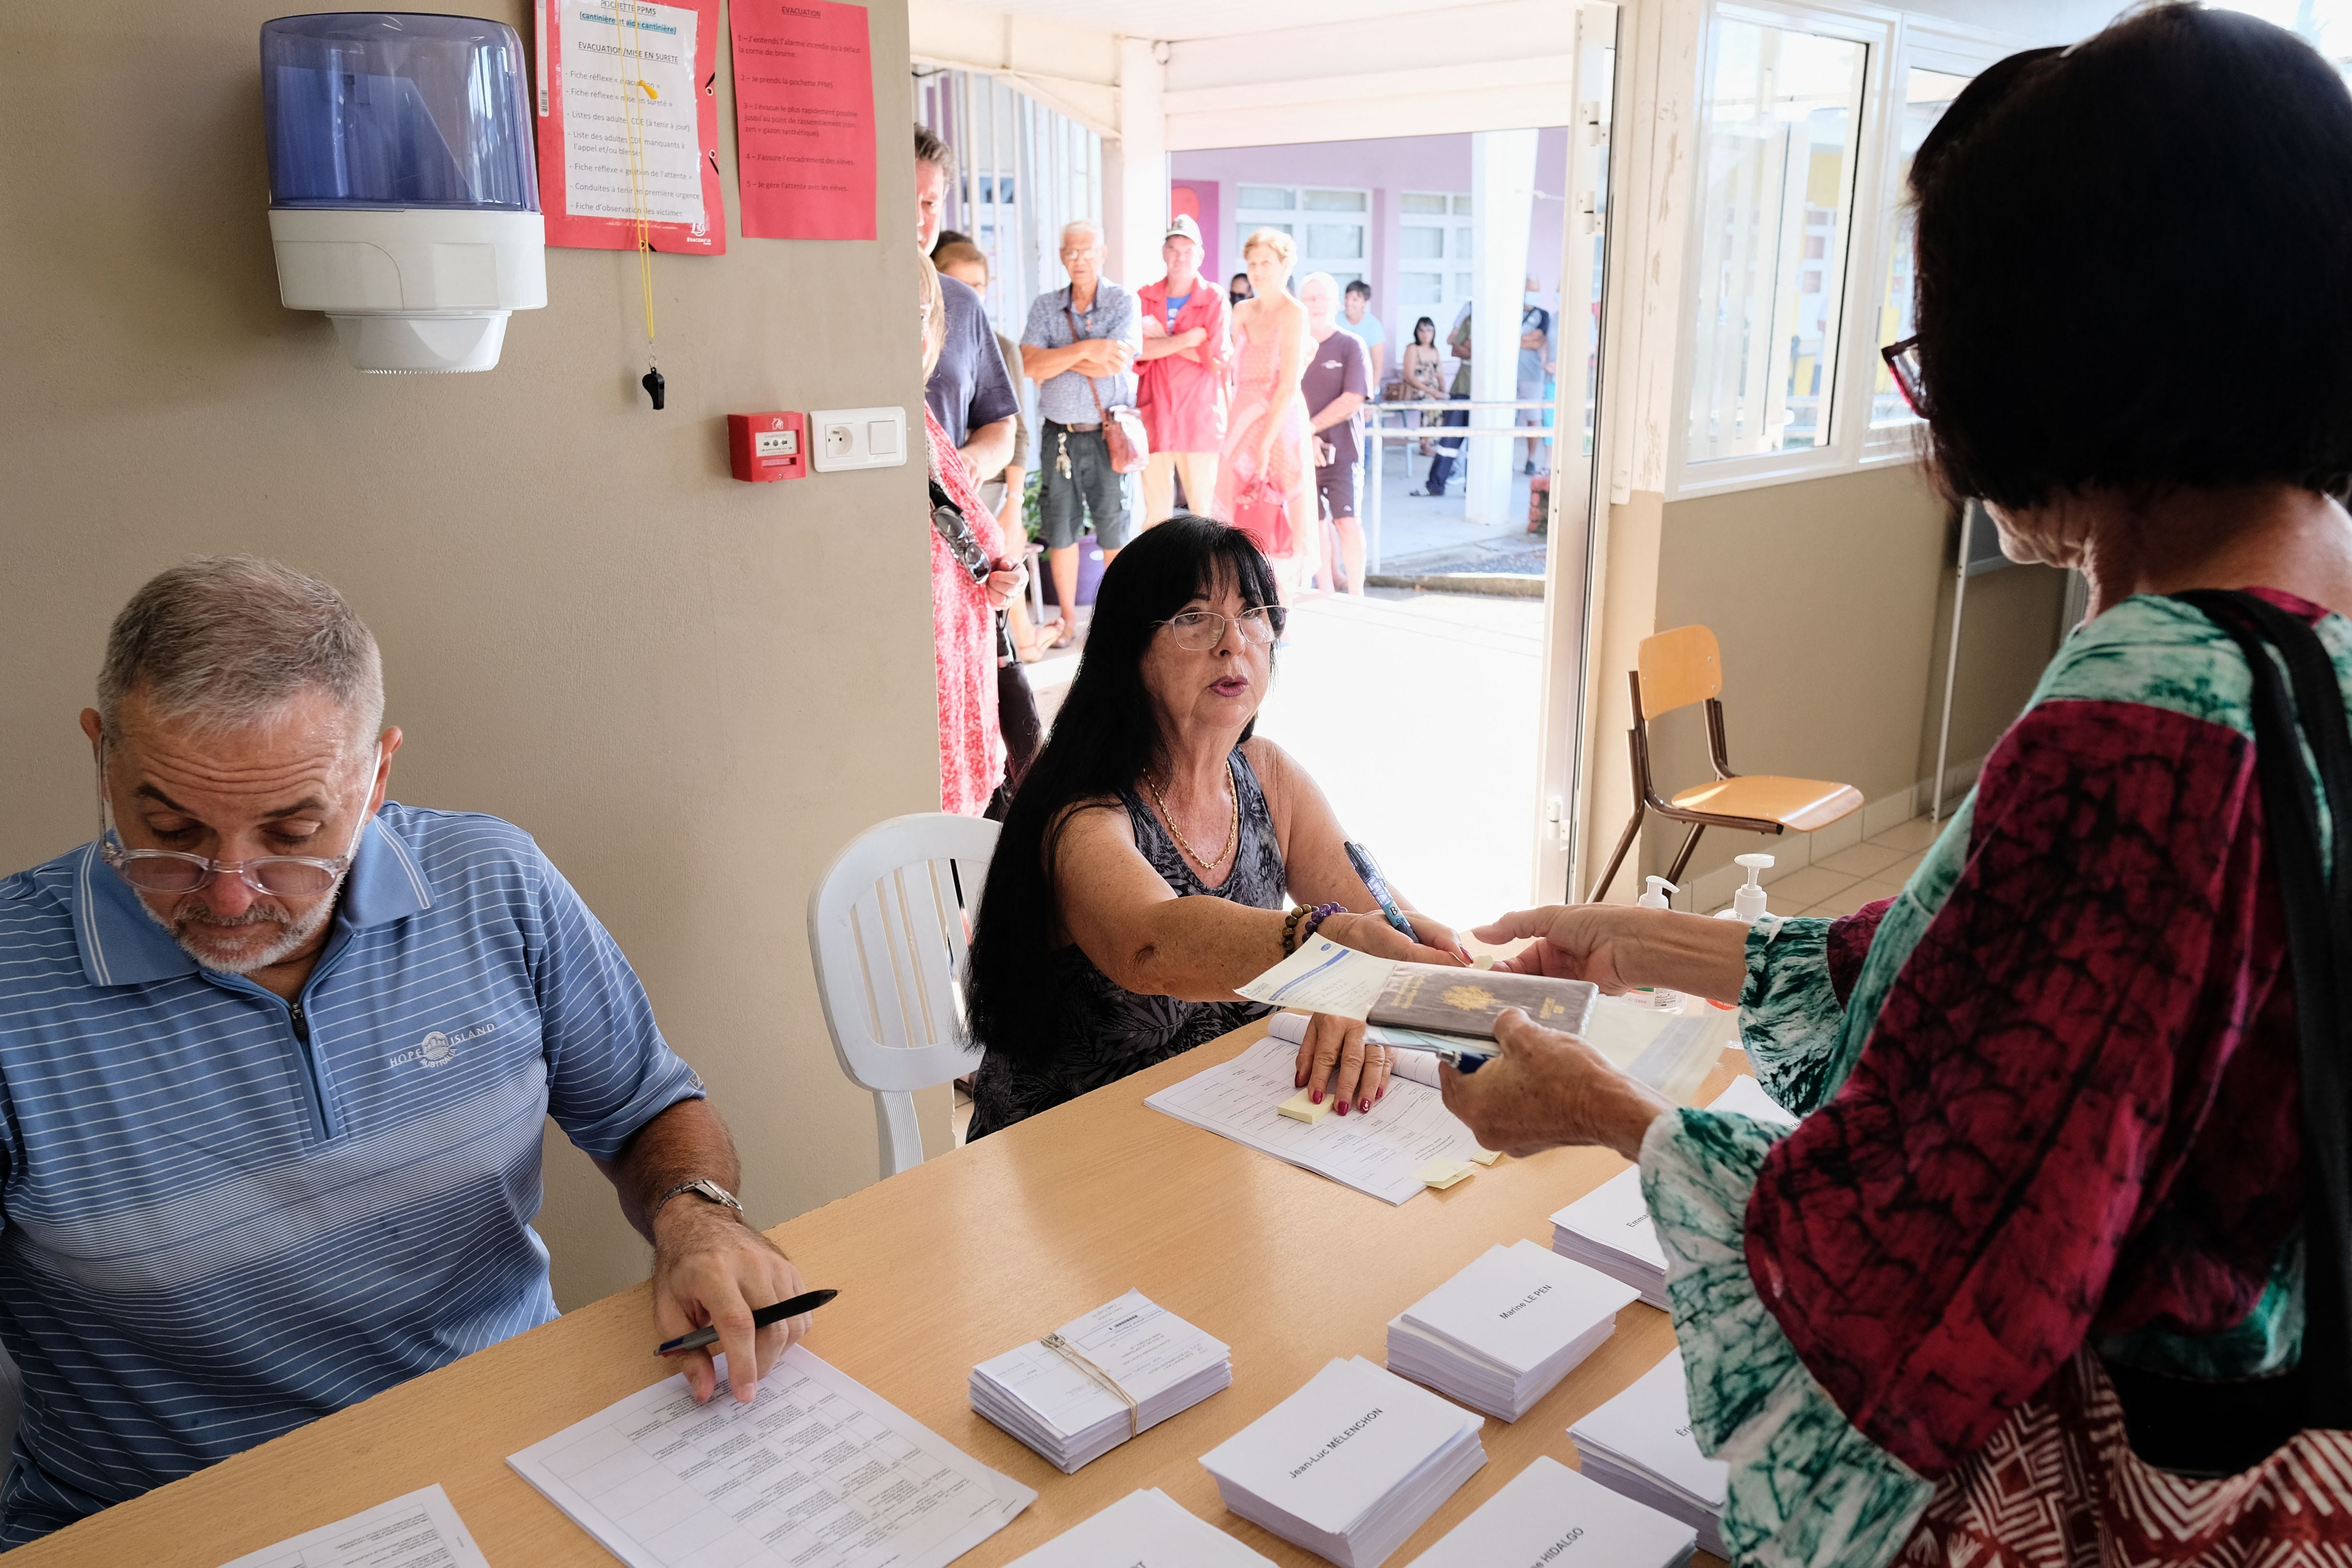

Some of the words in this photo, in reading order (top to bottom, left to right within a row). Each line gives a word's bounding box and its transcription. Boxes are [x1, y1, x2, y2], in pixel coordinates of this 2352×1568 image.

[637, 6, 656, 15] PPMS
[782, 6, 821, 17] EVACUATION
[580, 11, 616, 23] (cantinière
[641, 23, 677, 34] cantinière)
[807, 40, 829, 49] incendie
[656, 53, 678, 63] SURETE
[570, 71, 588, 79] Fiche
[589, 73, 612, 82] réflexe
[790, 79, 816, 87] pochette
[571, 88, 588, 97] Fiche
[590, 91, 613, 100] réflexe
[647, 99, 667, 107] sureté
[788, 106, 800, 114] plus
[802, 108, 834, 116] rapidement
[572, 111, 591, 119] Listes
[675, 123, 690, 132] jour)
[798, 118, 841, 127] rassemblement
[842, 120, 856, 129] (coin
[604, 134, 628, 143] adultes
[644, 139, 680, 149] manquants
[598, 145, 617, 154] et/ou
[575, 163, 593, 171] Fiche
[575, 182, 609, 192] Conduites
[645, 189, 674, 198] première
[576, 202, 593, 211] Fiche
[656, 209, 683, 217] victimes
[390, 1048, 423, 1067] HOPE
[450, 1023, 494, 1045] ISLAND
[420, 1048, 458, 1067] AUSTRALIA
[1499, 1299, 1527, 1320] Marine
[1524, 1291, 1537, 1305] LE
[1533, 1284, 1553, 1300] PEN
[1288, 1448, 1330, 1479] Jean-Luc
[1327, 1407, 1383, 1450] MÉLENCHON
[1539, 1527, 1584, 1563] HIDALGO
